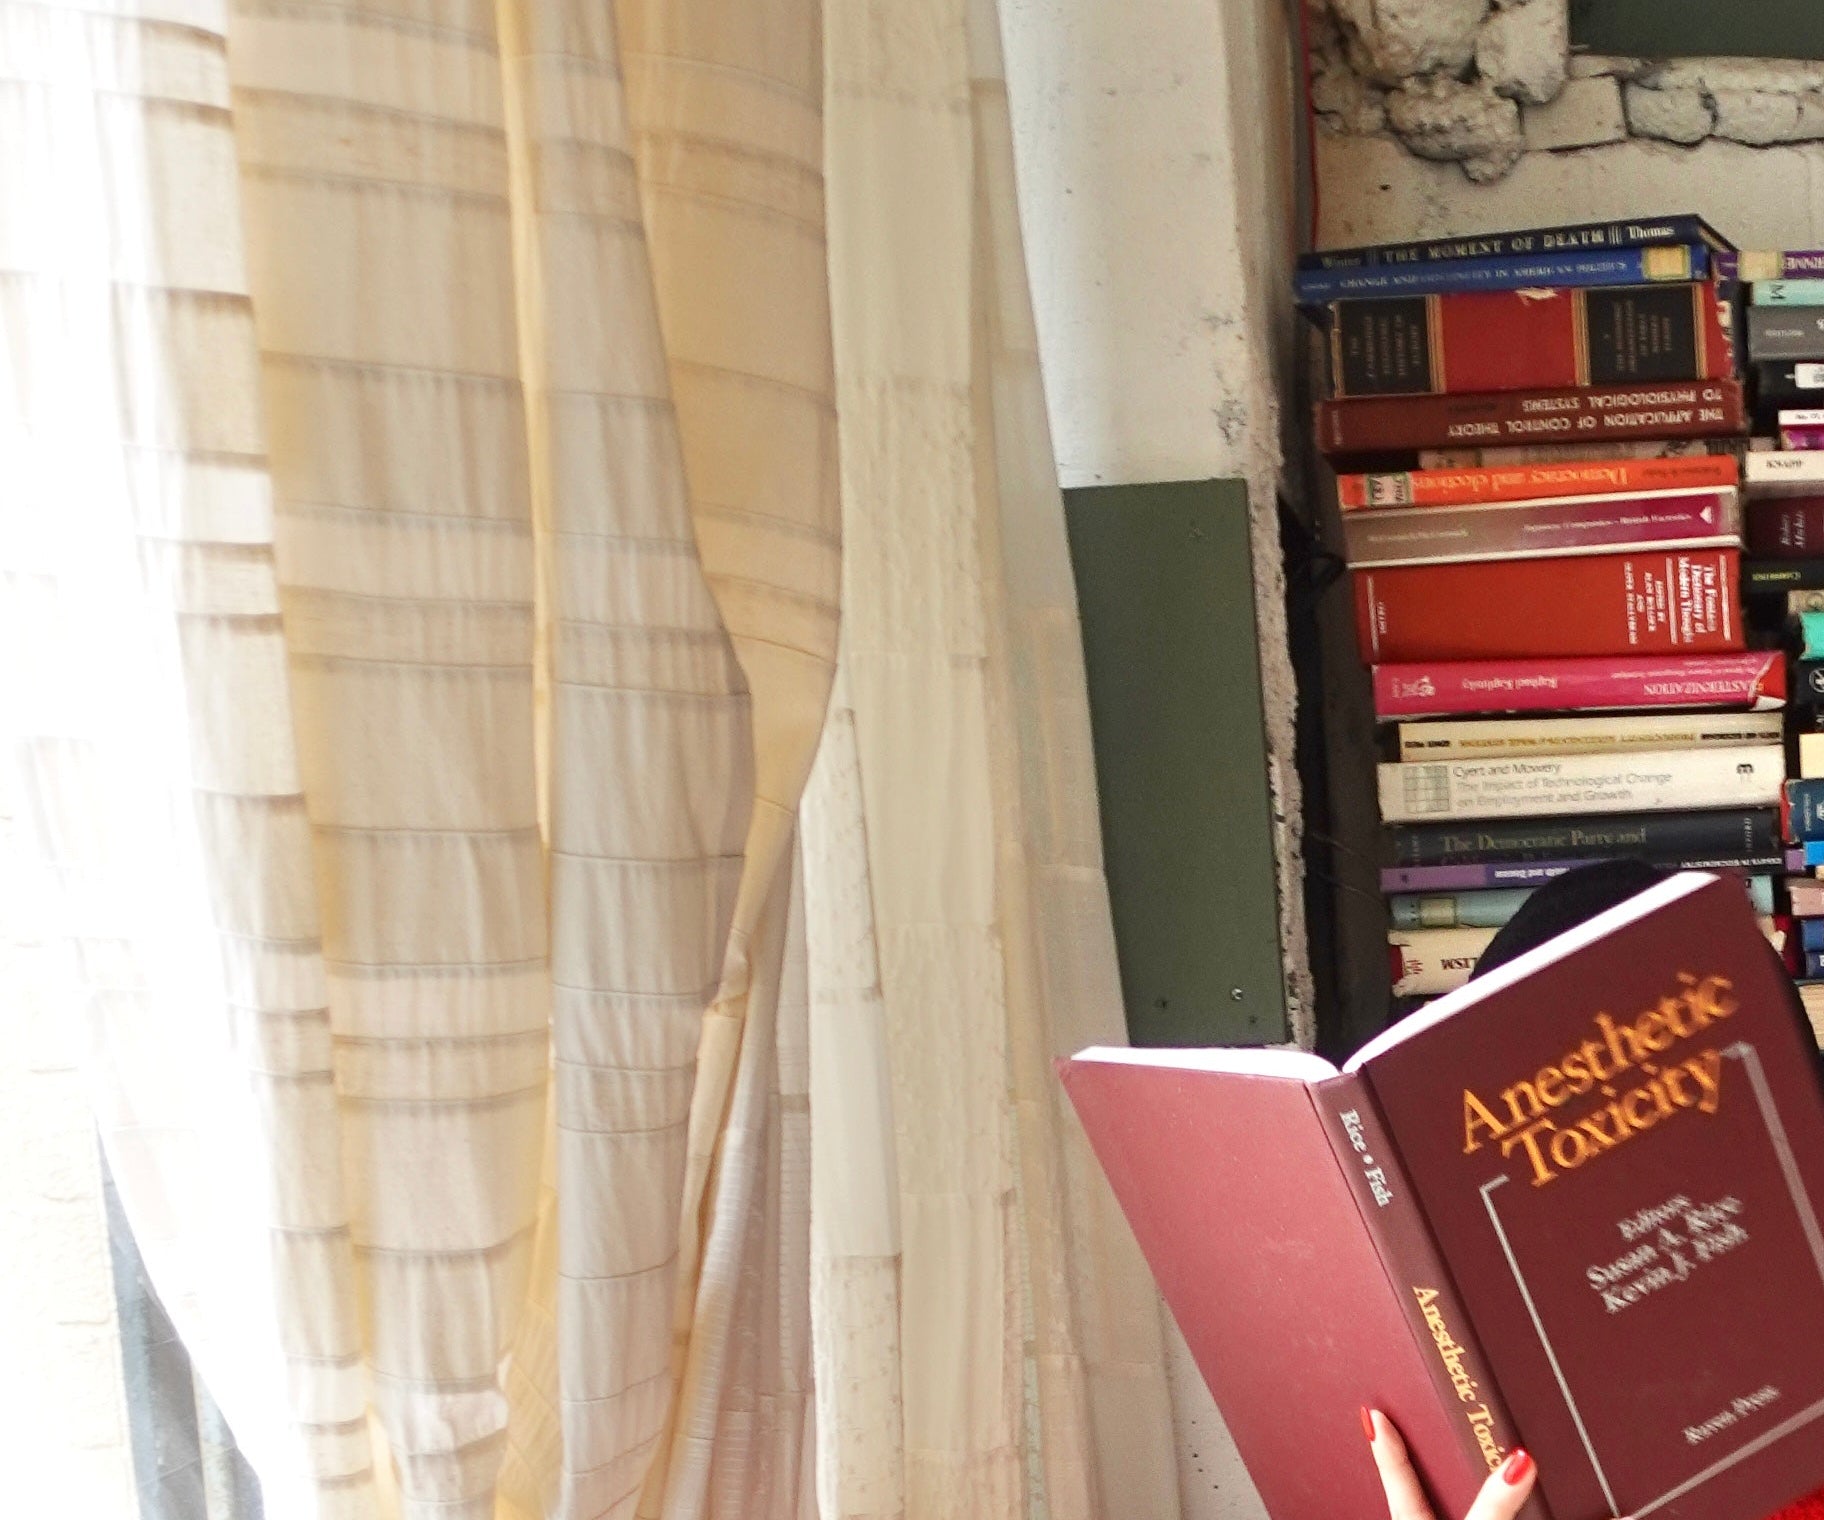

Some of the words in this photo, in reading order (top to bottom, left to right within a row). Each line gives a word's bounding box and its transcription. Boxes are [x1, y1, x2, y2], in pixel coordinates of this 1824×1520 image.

[1383, 248, 1418, 263] THE
[1429, 239, 1502, 260] MOMENT
[1512, 235, 1533, 251] OF
[1543, 228, 1604, 249] DEATH
[1626, 224, 1675, 241] Thomas
[1521, 396, 1582, 412] SYSTEMS
[1589, 390, 1697, 410] PHYSIOLOGICAL
[1702, 387, 1723, 401] TO
[1576, 415, 1598, 430] OF
[1605, 409, 1693, 429] APPLICATION
[1699, 407, 1725, 422] THE
[1448, 420, 1501, 438] THEORY
[1505, 416, 1573, 434] CONTROL
[1490, 471, 1525, 491] and
[1528, 467, 1628, 488] Democracy
[1679, 556, 1692, 598] Modern
[1703, 566, 1715, 590] The
[1452, 765, 1481, 778] Cyert
[1460, 971, 1739, 1156] Anesthetic
[1501, 1045, 1722, 1189] Toxicity
[1337, 1108, 1369, 1155] Rice
[1362, 1164, 1393, 1207] Fish
[1586, 1244, 1658, 1289] Susan
[1683, 1196, 1744, 1235] Rice
[1600, 1266, 1672, 1313] Kevin
[1691, 1222, 1750, 1263] Fish
[1412, 1283, 1476, 1406] Anesthetic
[1465, 1404, 1504, 1474] Toxic
